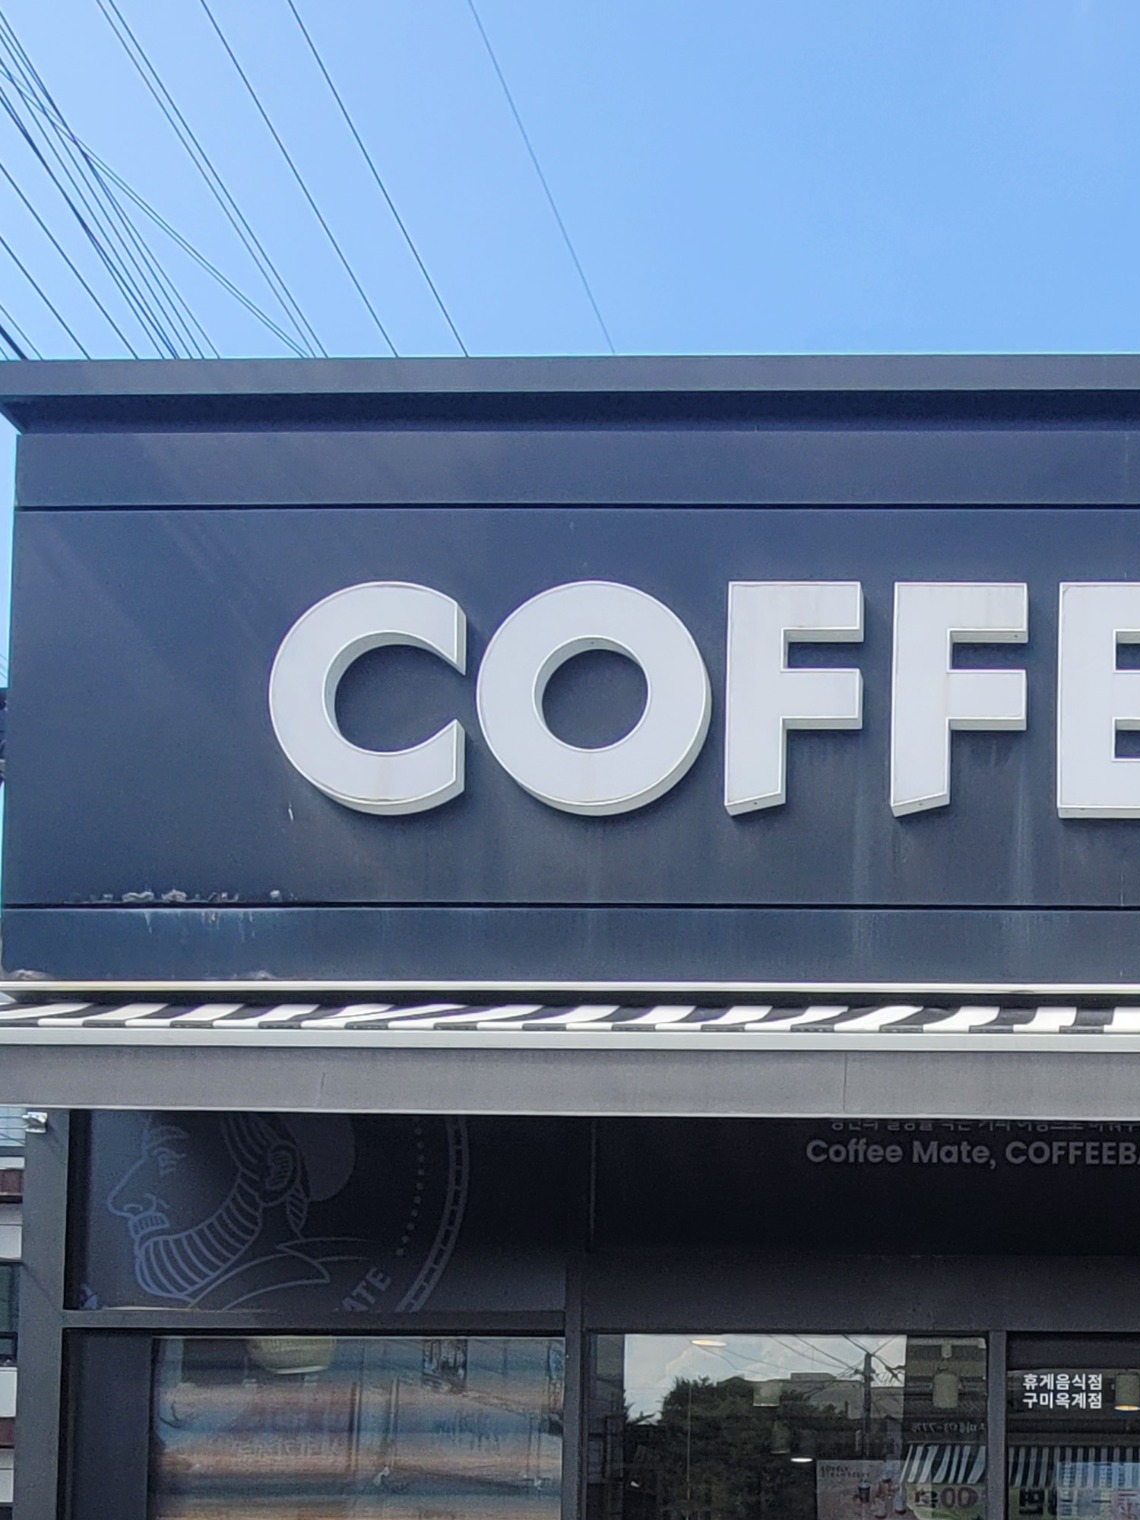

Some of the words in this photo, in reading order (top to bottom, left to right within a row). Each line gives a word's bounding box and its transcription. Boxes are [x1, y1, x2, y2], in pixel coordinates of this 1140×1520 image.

[805, 1138, 904, 1164] Coffee
[911, 1140, 997, 1170] Mate,
[334, 1266, 392, 1312] ATE
[1022, 1372, 1103, 1391] 휴게음식점
[1022, 1391, 1103, 1410] 구미옥계점
